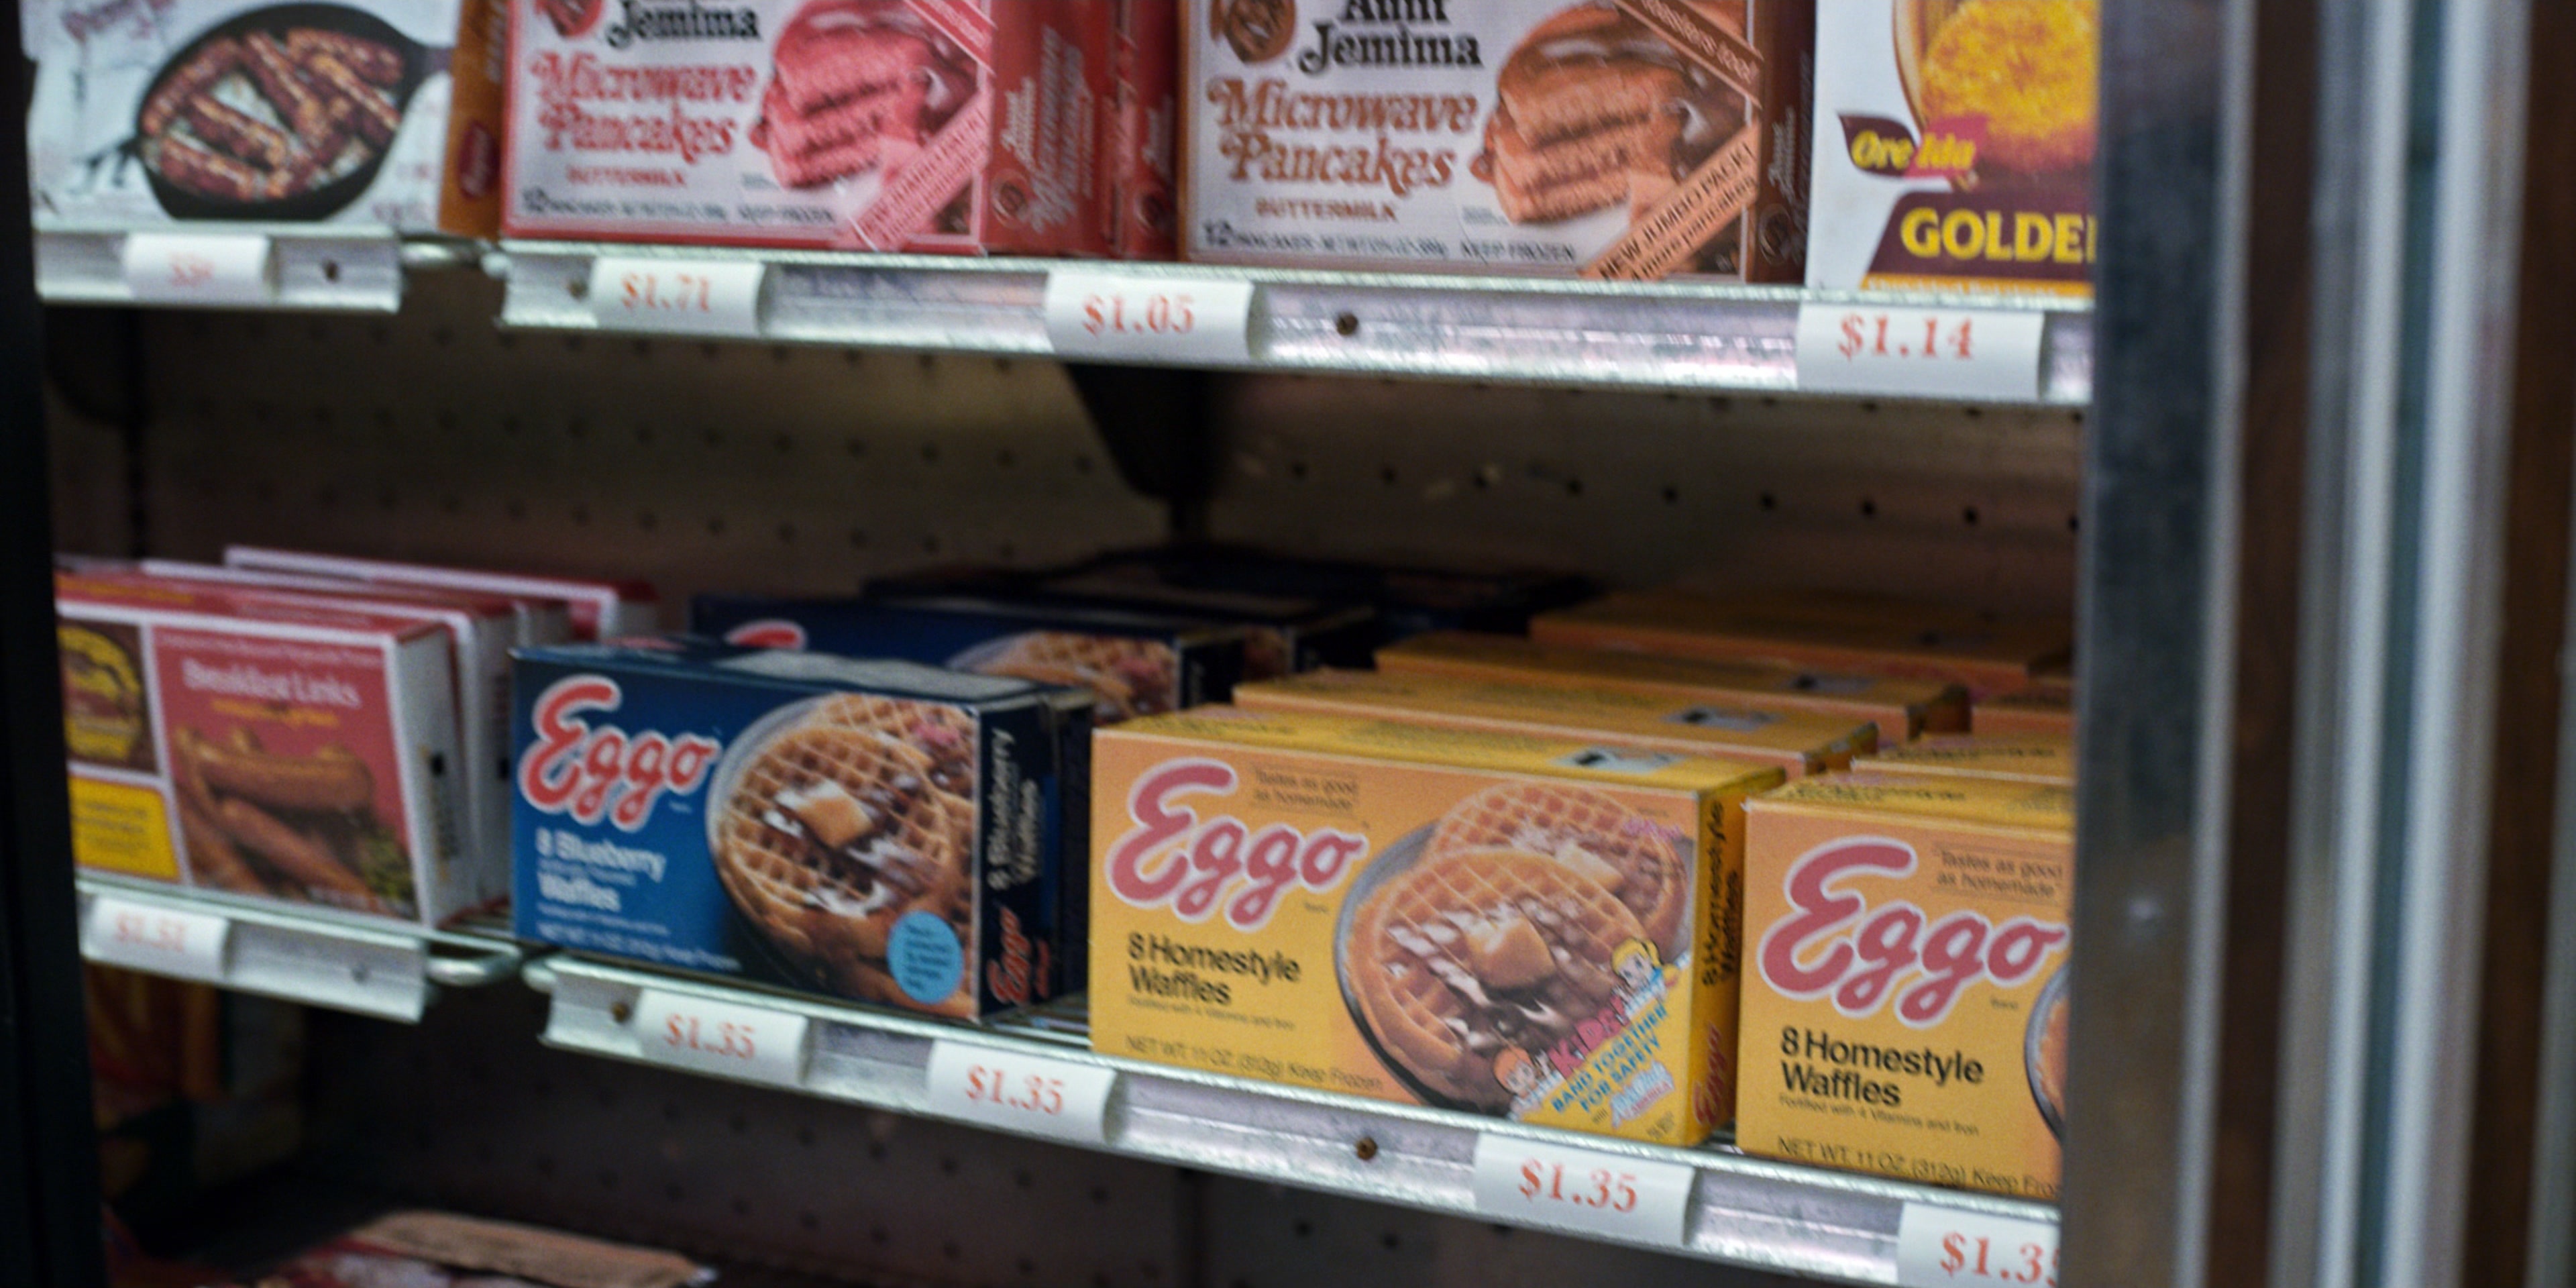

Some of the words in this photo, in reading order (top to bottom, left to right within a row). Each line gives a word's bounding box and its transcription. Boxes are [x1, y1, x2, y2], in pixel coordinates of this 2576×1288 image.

[606, 0, 761, 49] Jemima
[1297, 20, 1483, 76] Jemima
[530, 51, 756, 103] Microwave
[1207, 78, 1480, 132] Microwave
[538, 102, 737, 164] Pancakes
[1850, 129, 1913, 170] Ore
[1220, 131, 1456, 197] Pancakes
[1255, 197, 1399, 223] BUTTERMILK
[620, 272, 713, 316] $1.71
[1081, 294, 1195, 337] $1.05
[1838, 312, 1974, 361] $1.14
[518, 674, 722, 833] Eggo
[1105, 757, 1369, 932] Eggo
[1128, 932, 1144, 960] 8
[1148, 933, 1301, 986] Homestyle
[1757, 835, 2071, 1029] Eggo
[1128, 963, 1232, 1005] Waffles
[664, 1014, 756, 1061] $1.35
[1126, 1034, 1159, 1054] NET
[1547, 996, 1631, 1080] KIDS!
[1551, 1070, 1593, 1114] BAND
[1592, 1003, 1668, 1075] TOGETHER
[1780, 1026, 1800, 1058] 8
[1805, 1028, 1984, 1087] Homestyle
[965, 1065, 1067, 1116] $1.35
[1579, 1079, 1611, 1114] FOR
[1611, 1031, 1662, 1084] SAFETY
[1692, 1020, 1728, 1126] Eggo
[1781, 1061, 1902, 1108] Waffles
[1927, 1118, 1951, 1134] and
[1517, 1157, 1638, 1214] $1.35
[1778, 1135, 1817, 1157] NET
[1856, 1150, 1874, 1167] 11
[1972, 1167, 2019, 1191] Keep
